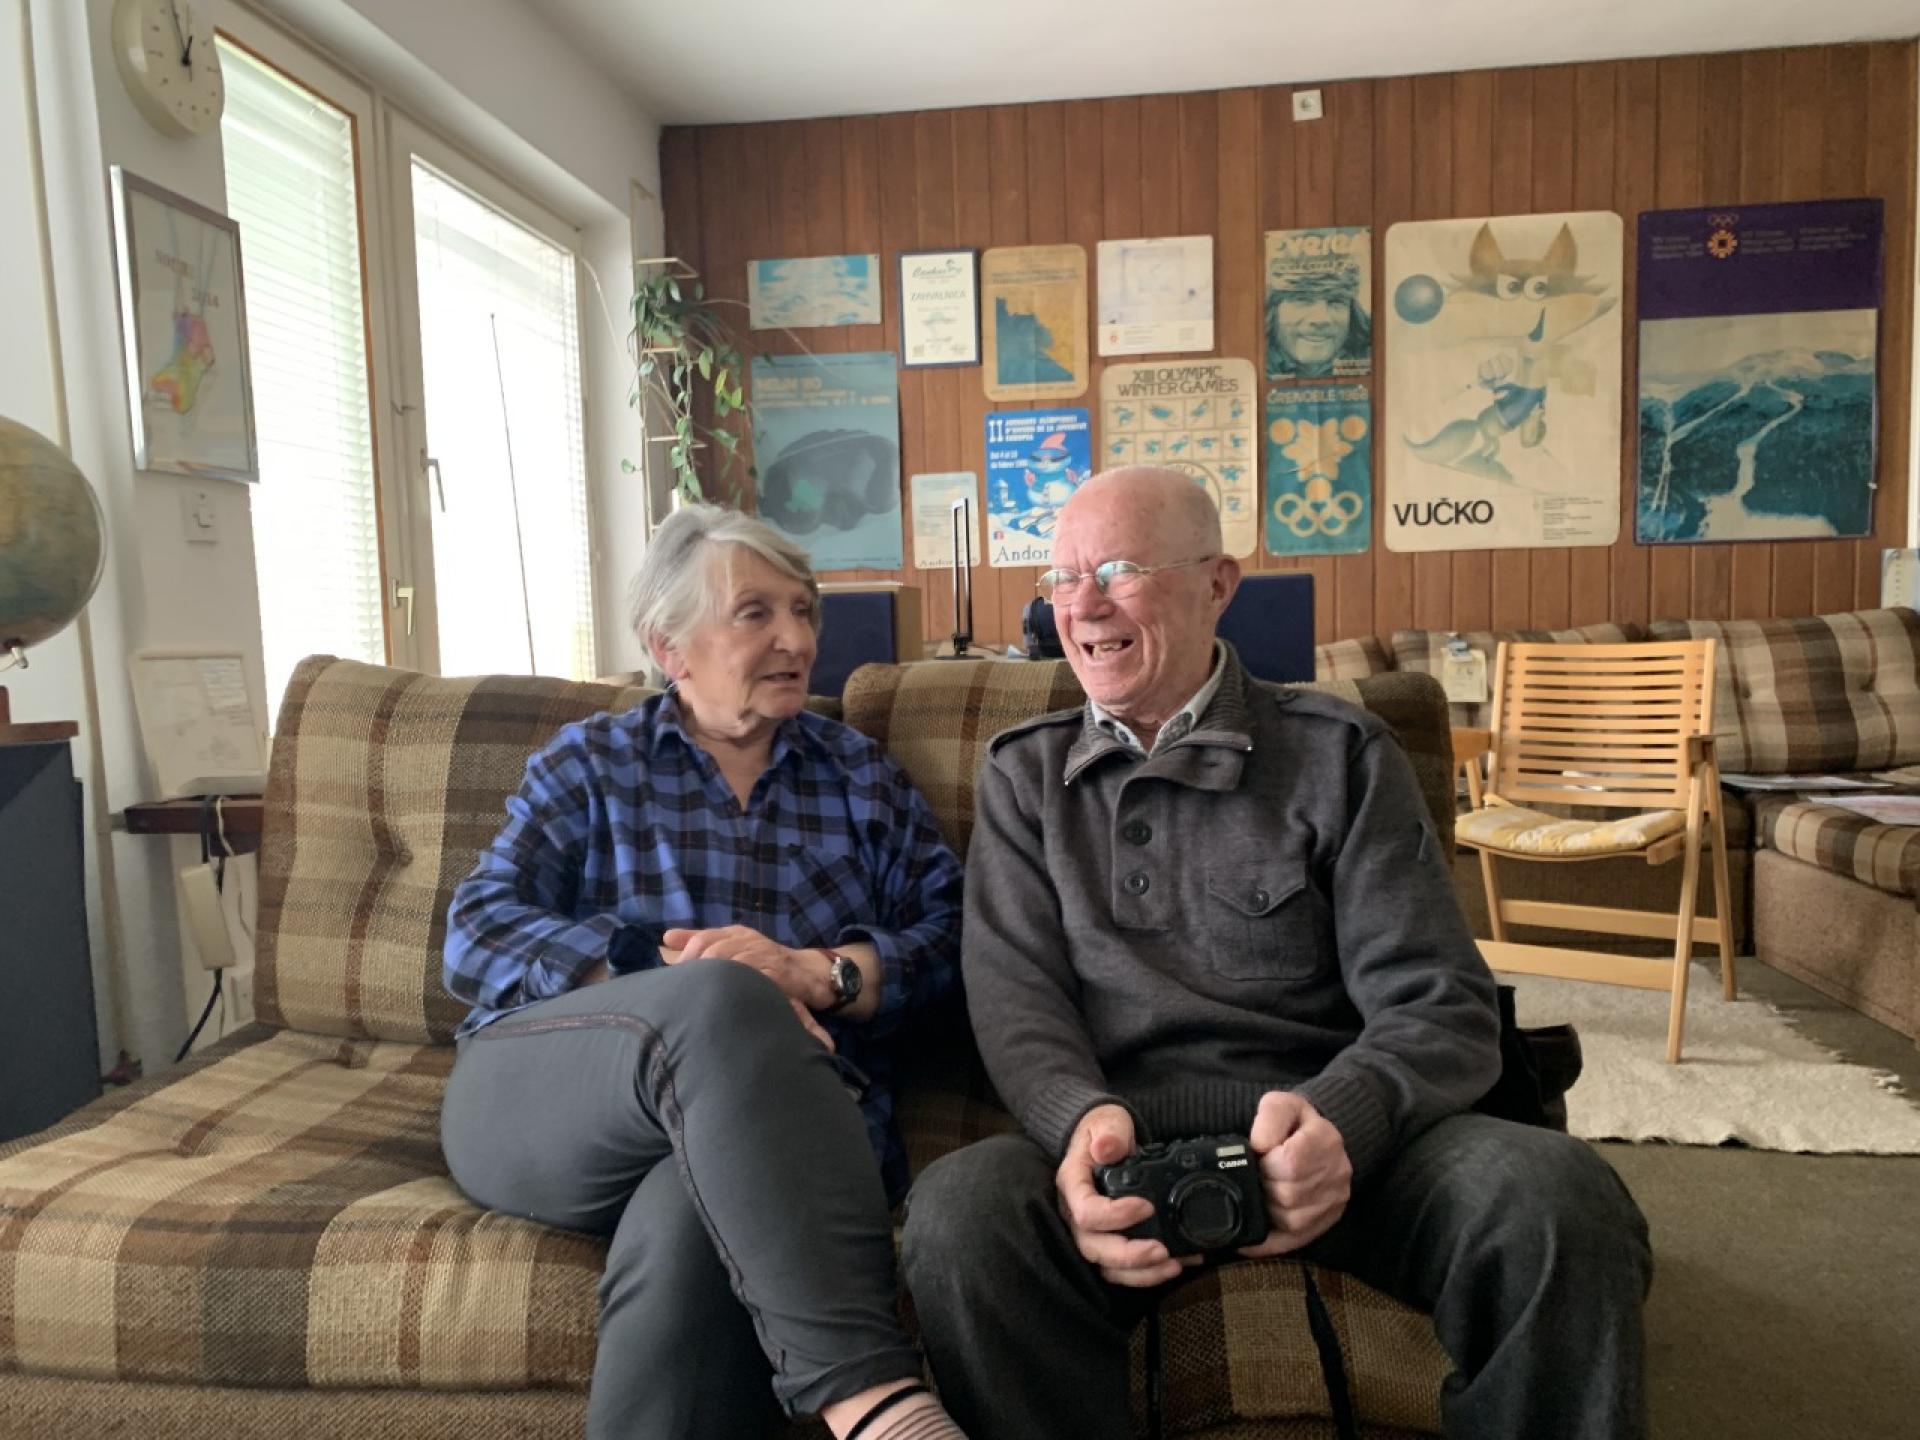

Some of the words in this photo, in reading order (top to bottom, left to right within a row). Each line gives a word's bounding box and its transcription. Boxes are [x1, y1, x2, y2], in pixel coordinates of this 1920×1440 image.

[1157, 365, 1222, 382] OLYMPIC
[1118, 382, 1177, 396] WINTER
[1179, 378, 1239, 394] GAMES
[1267, 390, 1336, 405] GRENOBLE
[1393, 498, 1495, 526] VUČKO
[993, 544, 1050, 564] Andor
[1218, 1159, 1248, 1169] Canon
